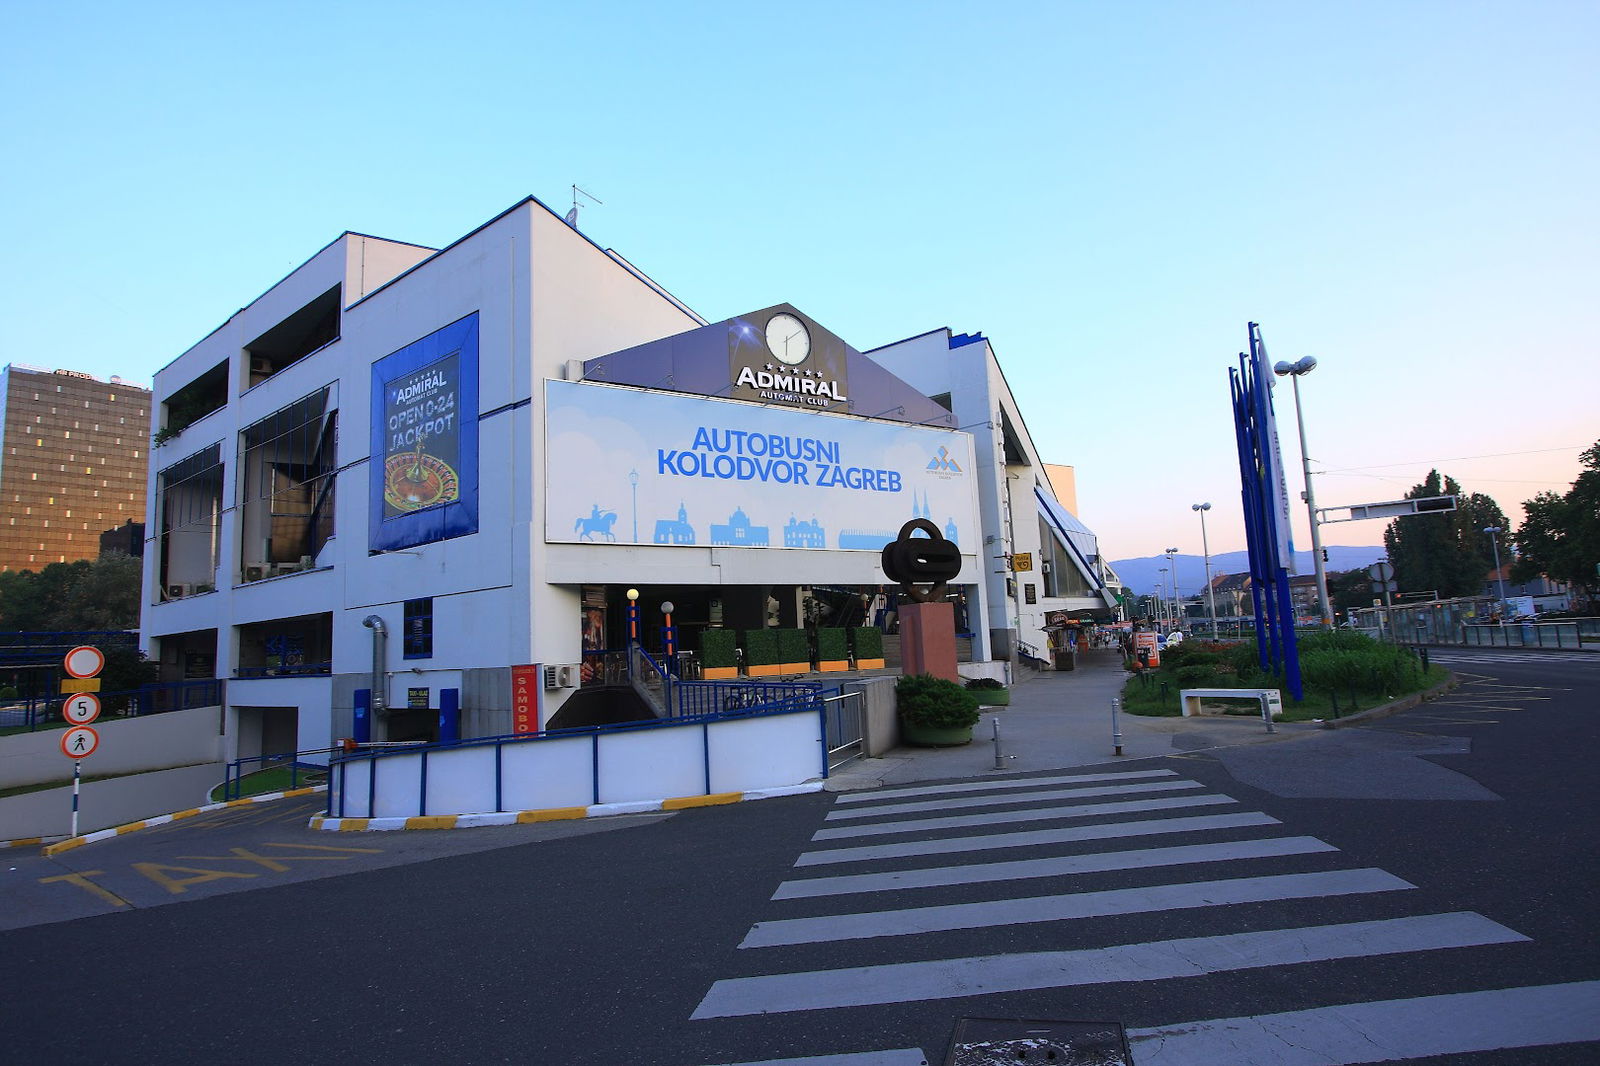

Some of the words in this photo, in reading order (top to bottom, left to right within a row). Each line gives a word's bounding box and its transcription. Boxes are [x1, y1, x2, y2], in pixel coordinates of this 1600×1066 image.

[396, 371, 447, 405] ADMIRAL
[737, 366, 847, 402] ADMIRAL
[760, 391, 804, 403] AUTOMAT
[807, 397, 829, 407] CLUB
[389, 403, 424, 431] OPEN
[426, 391, 455, 418] 0-24
[389, 412, 455, 452] JACKPOT
[692, 426, 840, 464] AUTOBUSNI
[658, 449, 809, 485] KOLODVOR
[816, 464, 902, 492] ZAGREB
[77, 701, 87, 717] 5
[517, 677, 529, 739] SAMOBO
[37, 843, 384, 907] TAXI
